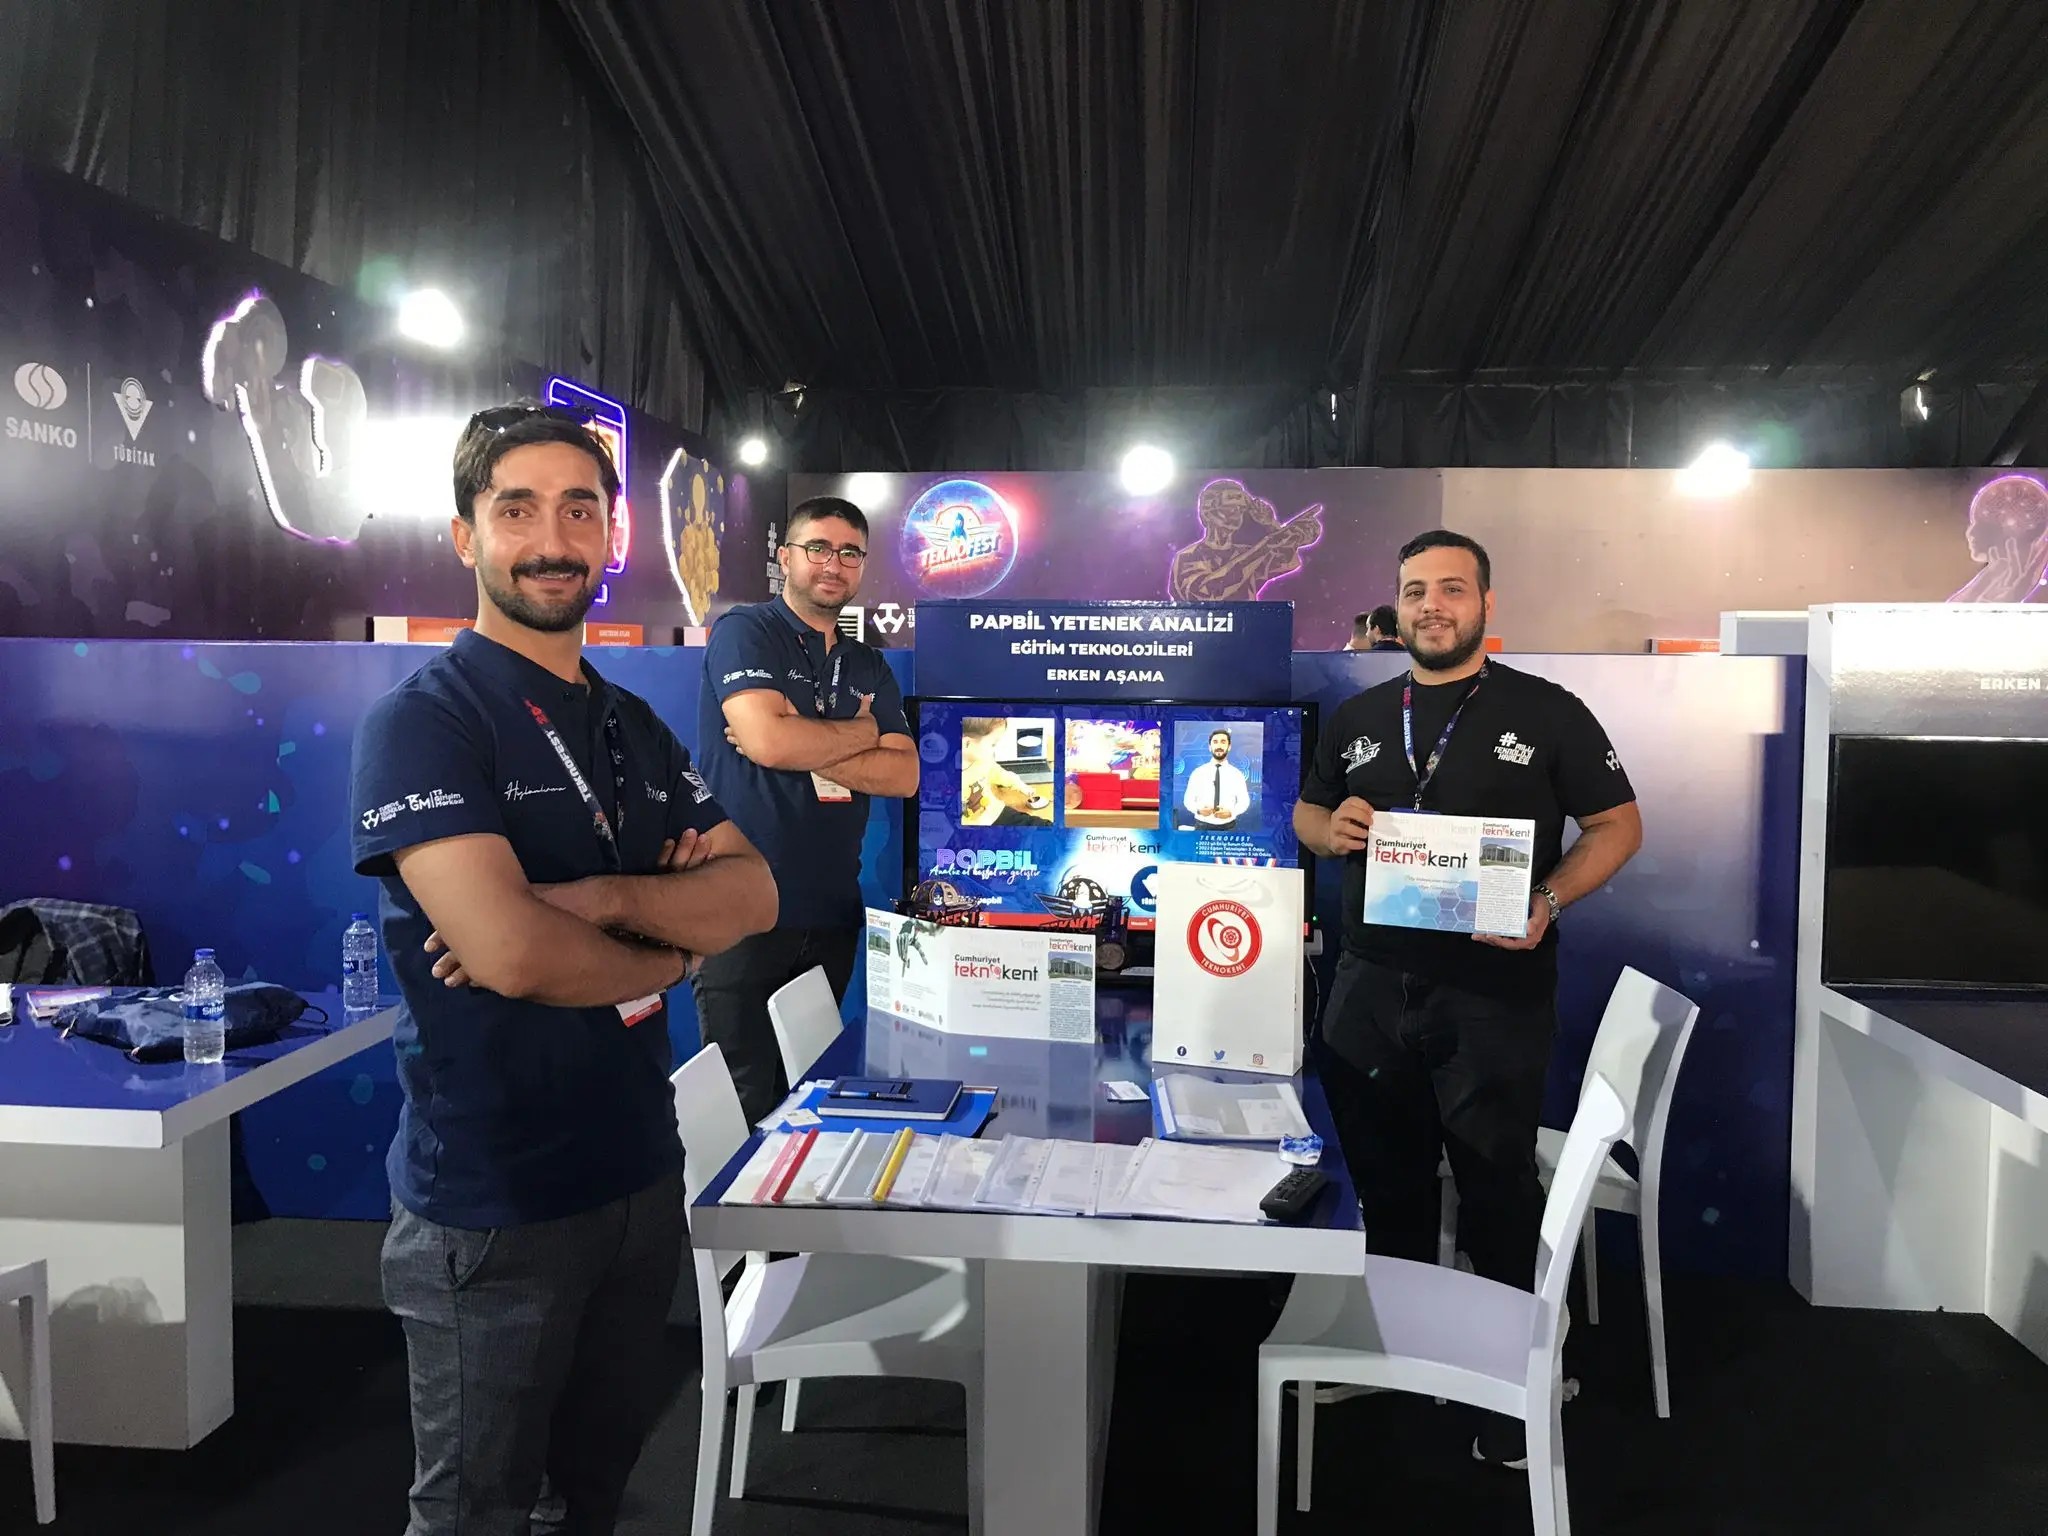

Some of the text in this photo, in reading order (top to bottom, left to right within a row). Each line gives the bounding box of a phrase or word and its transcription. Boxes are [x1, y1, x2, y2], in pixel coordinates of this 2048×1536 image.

[5, 416, 78, 448] SANKO
[113, 444, 156, 467] TÜBİTAK
[920, 533, 1002, 569] TEKNOFEST
[969, 610, 1234, 632] PAPBİL YETENEK ANALİZİ
[1010, 639, 1193, 657] EĞİTİM TEKNOLOJİLERİ
[1047, 668, 1164, 685] ERKEN AŞAMA
[1980, 677, 2041, 690] ERKEN
[544, 729, 592, 803] TEKNOFEST
[1375, 839, 1427, 850] Cumhuriyet
[954, 954, 1001, 965] Cumhuriyet
[1200, 957, 1246, 975] TEKNOKENT
